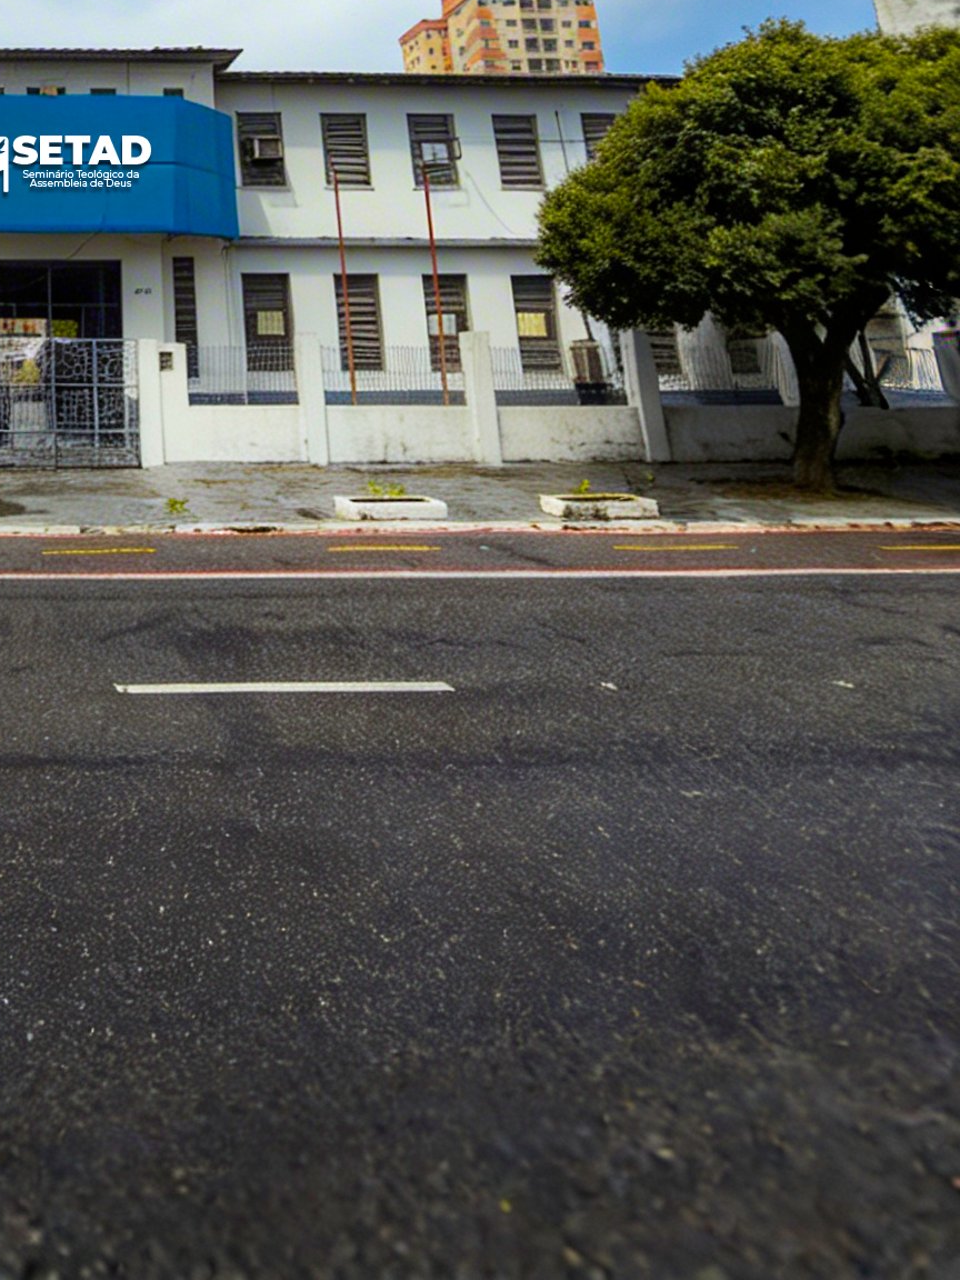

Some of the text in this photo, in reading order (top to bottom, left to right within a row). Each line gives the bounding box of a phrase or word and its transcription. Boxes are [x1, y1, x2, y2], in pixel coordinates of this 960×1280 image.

[13, 135, 152, 165] SETAD
[22, 170, 140, 181] Seminário Teológico da
[30, 179, 132, 188] Assembleia de Deus
